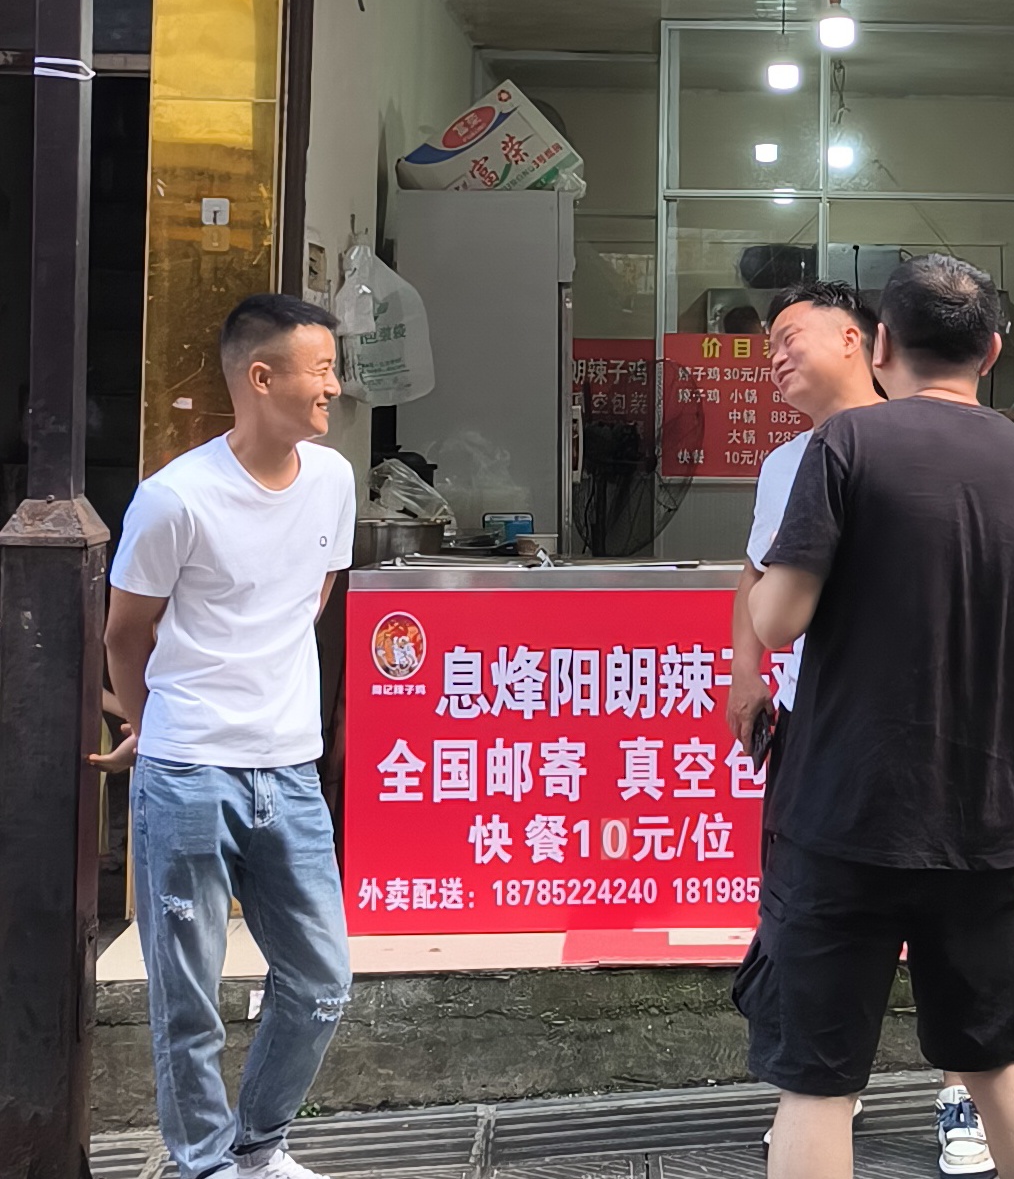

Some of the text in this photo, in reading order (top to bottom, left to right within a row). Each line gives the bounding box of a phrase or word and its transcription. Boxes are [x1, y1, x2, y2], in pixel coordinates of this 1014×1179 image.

[770, 409, 801, 425] 88元
[376, 737, 587, 802] 全国邮寄
[468, 812, 735, 865] 快餐10元/位
[492, 878, 658, 906] 18785224240
[672, 876, 761, 904] 181985
